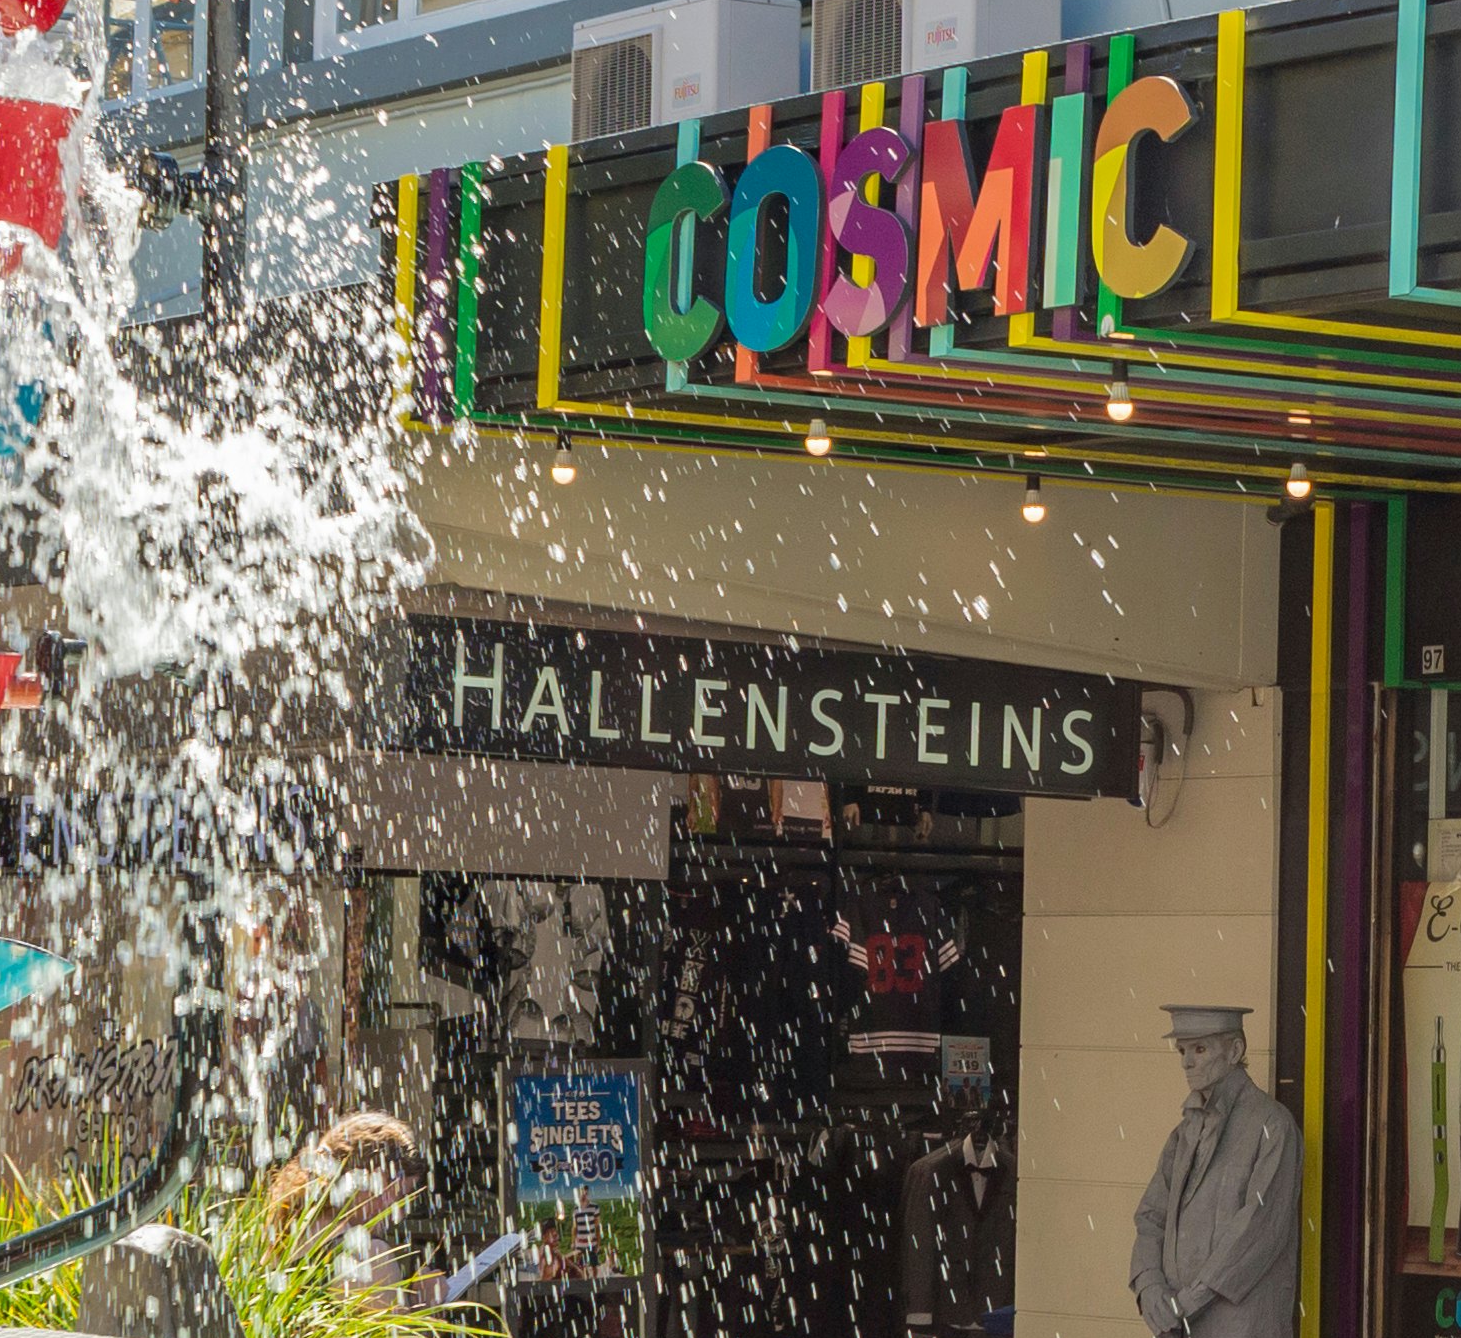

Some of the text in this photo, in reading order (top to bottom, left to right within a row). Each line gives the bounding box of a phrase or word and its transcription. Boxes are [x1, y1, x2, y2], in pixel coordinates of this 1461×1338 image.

[926, 21, 957, 47] FUJITSU
[674, 79, 700, 101] FUJITSU
[642, 75, 1201, 364] COSMIC
[1423, 648, 1444, 671] 97
[451, 641, 1097, 776] HALLENSTEINS
[1445, 960, 1461, 972] THE
[552, 1100, 602, 1122] TEES
[530, 1123, 624, 1155] SINGLETS
